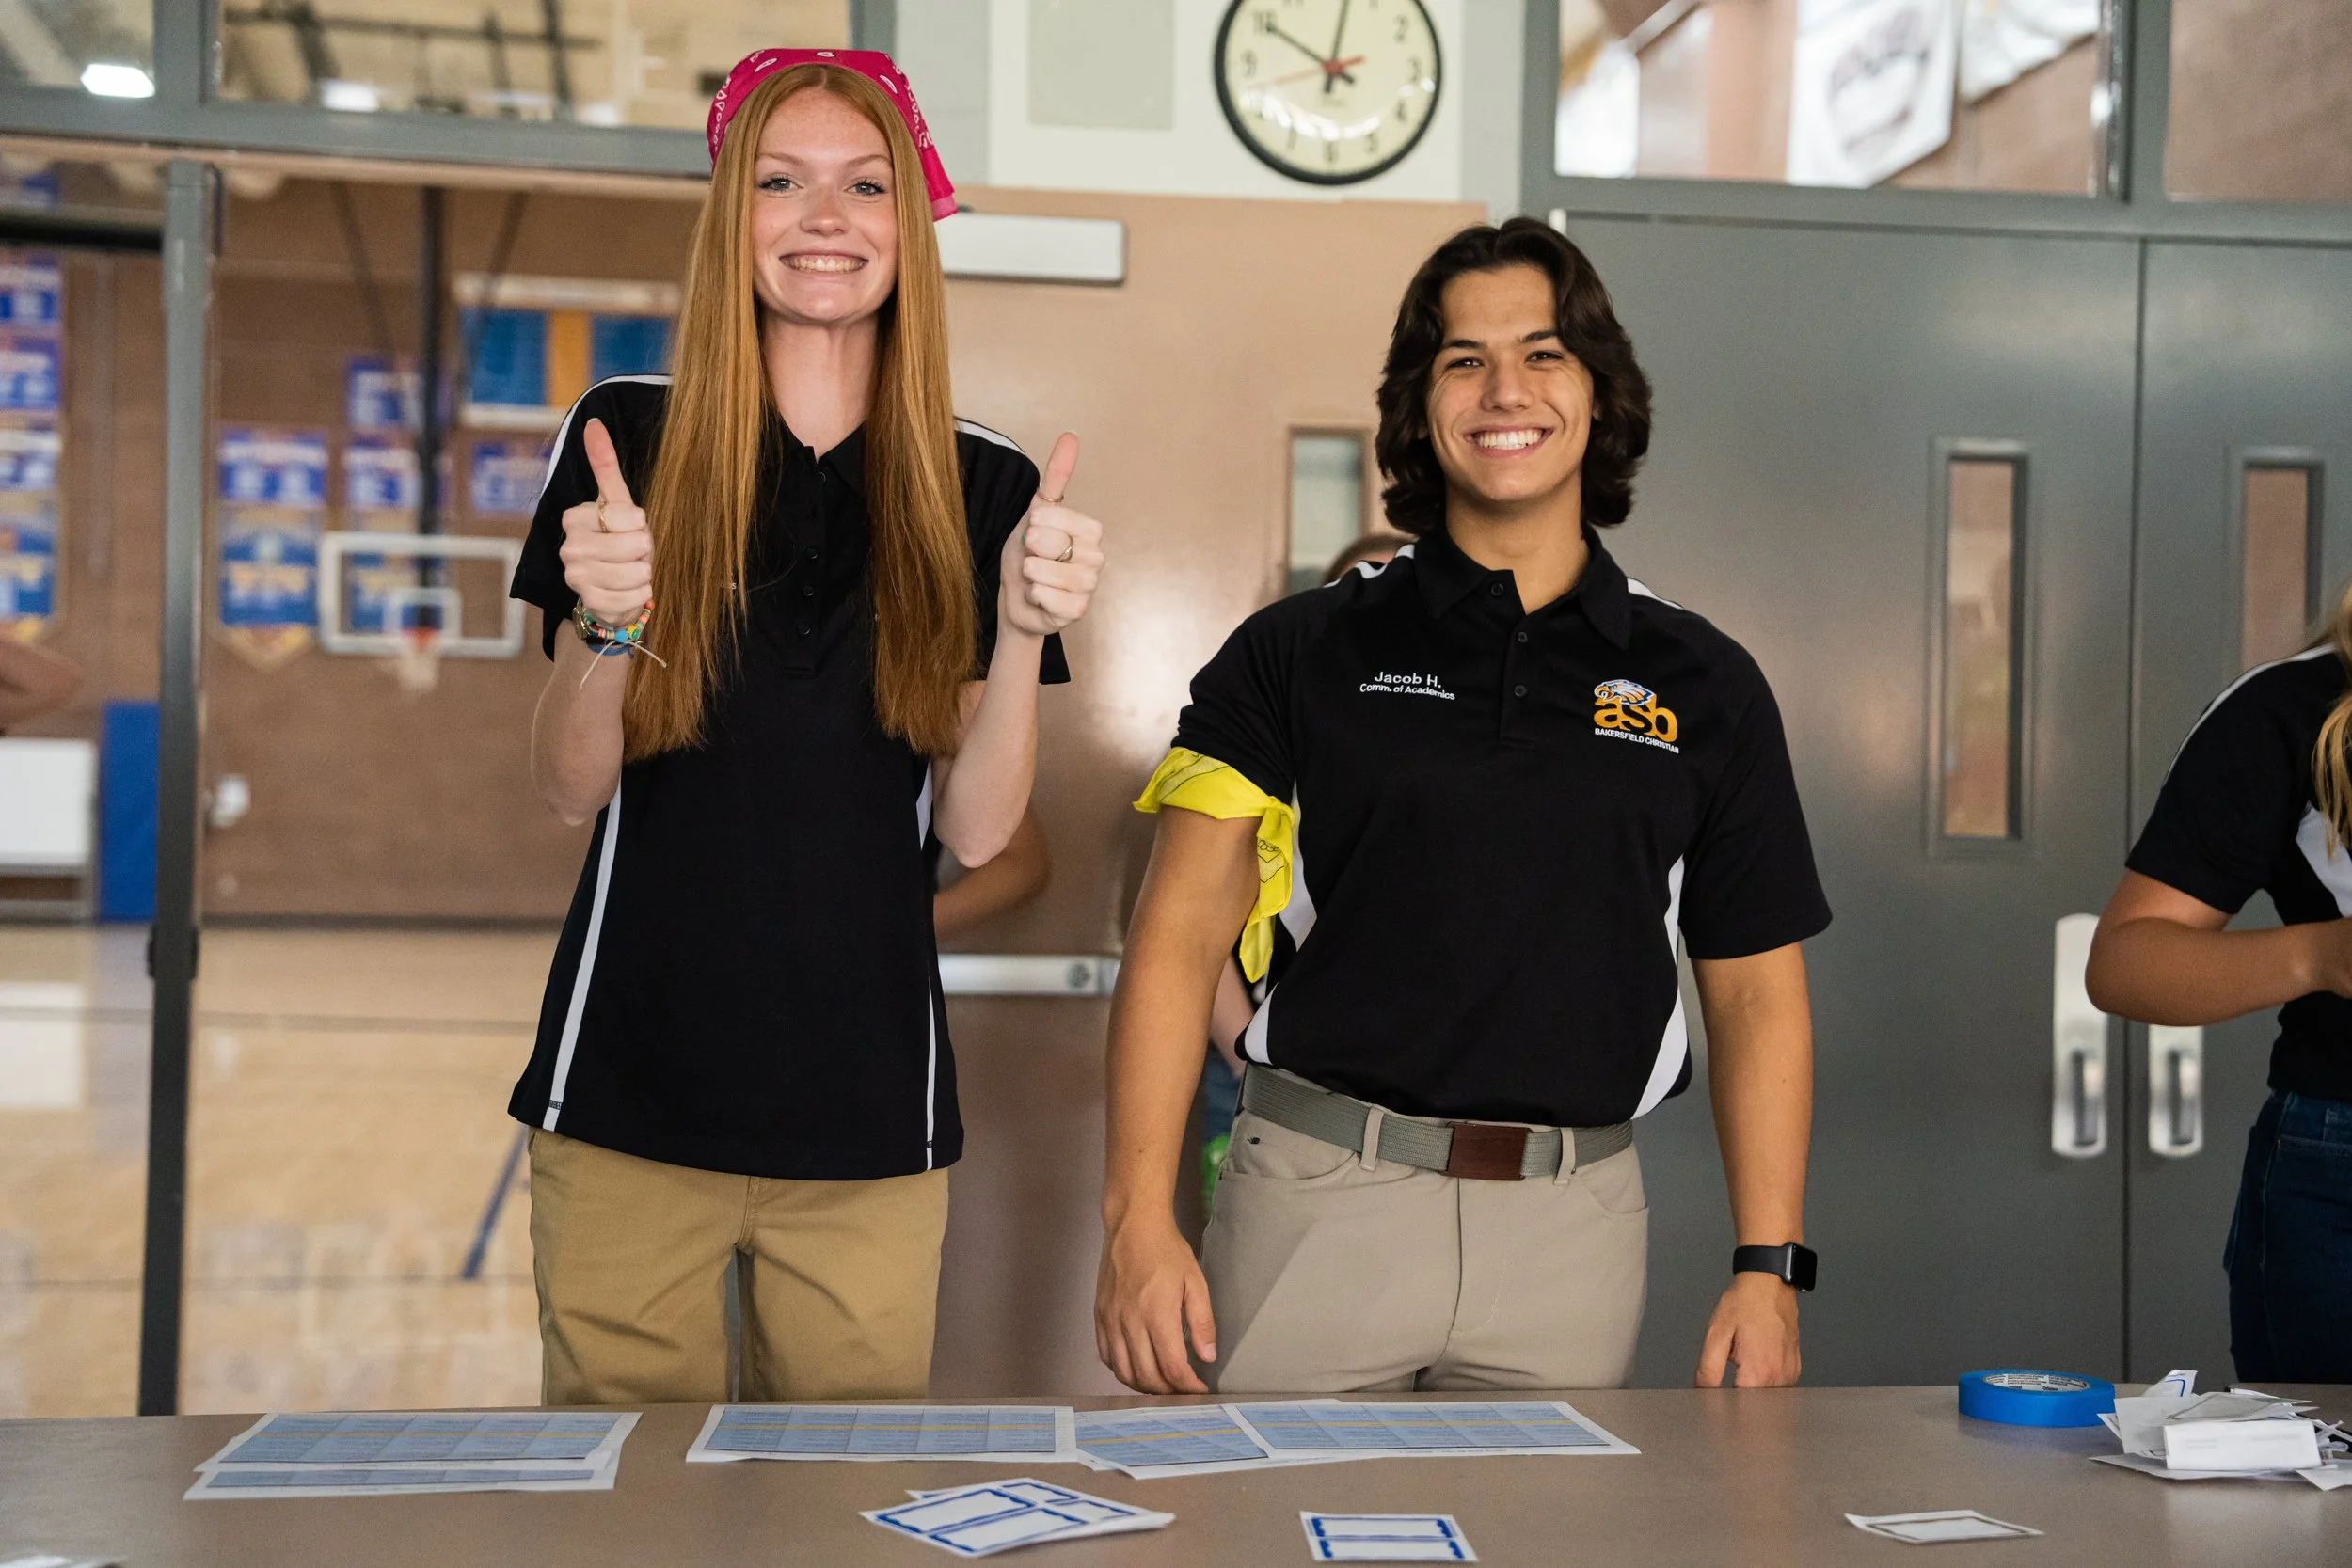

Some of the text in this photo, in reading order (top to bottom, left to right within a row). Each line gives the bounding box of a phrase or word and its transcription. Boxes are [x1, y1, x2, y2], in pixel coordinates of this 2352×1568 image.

[1374, 671, 1442, 689] Jacob H.
[1359, 683, 1456, 701] Comm. of Academics
[1593, 693, 1678, 743] asb
[1594, 727, 1680, 754] BAKERSFIELD CHRISTIAN
